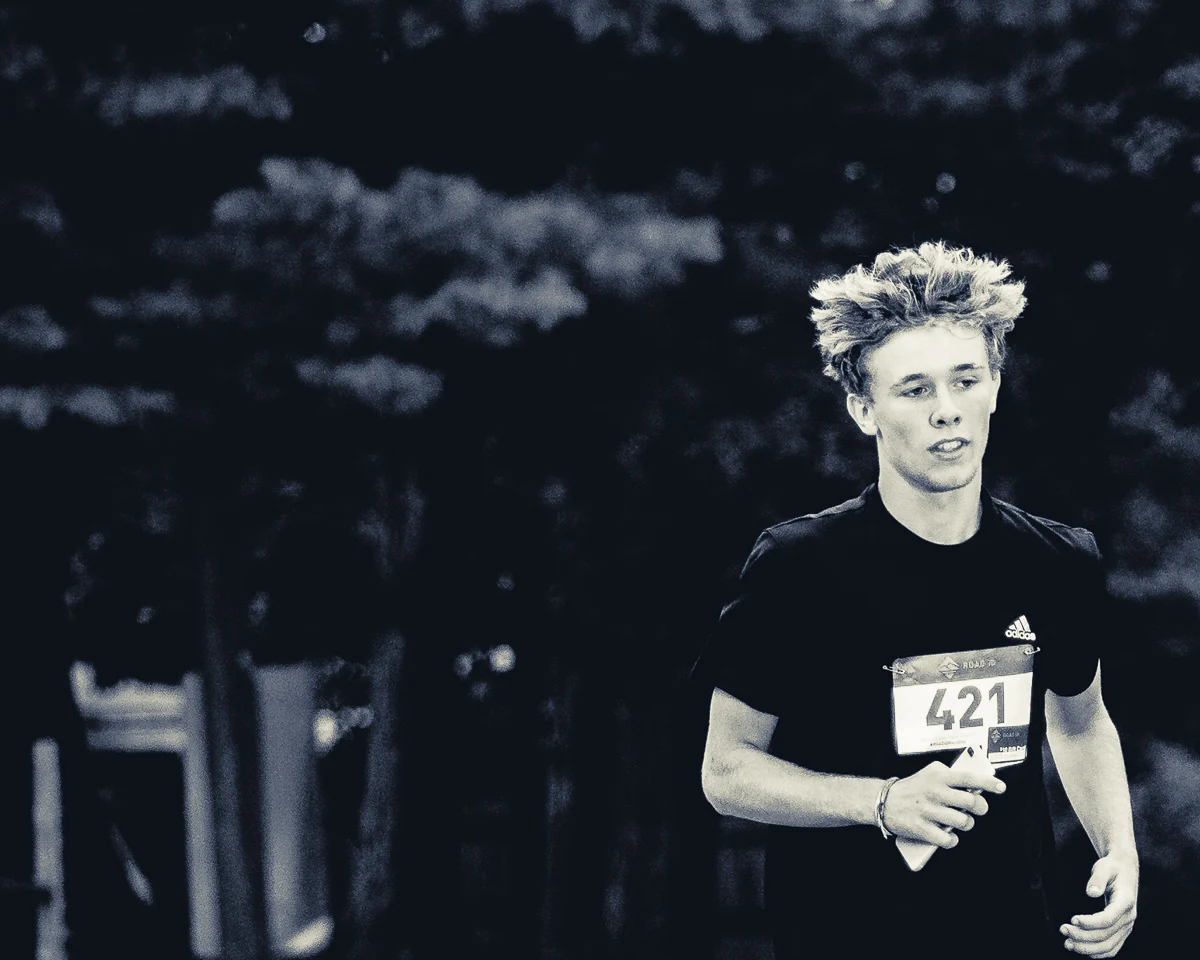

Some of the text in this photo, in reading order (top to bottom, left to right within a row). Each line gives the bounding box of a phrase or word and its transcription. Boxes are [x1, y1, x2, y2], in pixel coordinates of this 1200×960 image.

[1004, 629, 1036, 641] adidas
[963, 660, 985, 669] ROAD
[926, 682, 1005, 731] 421
